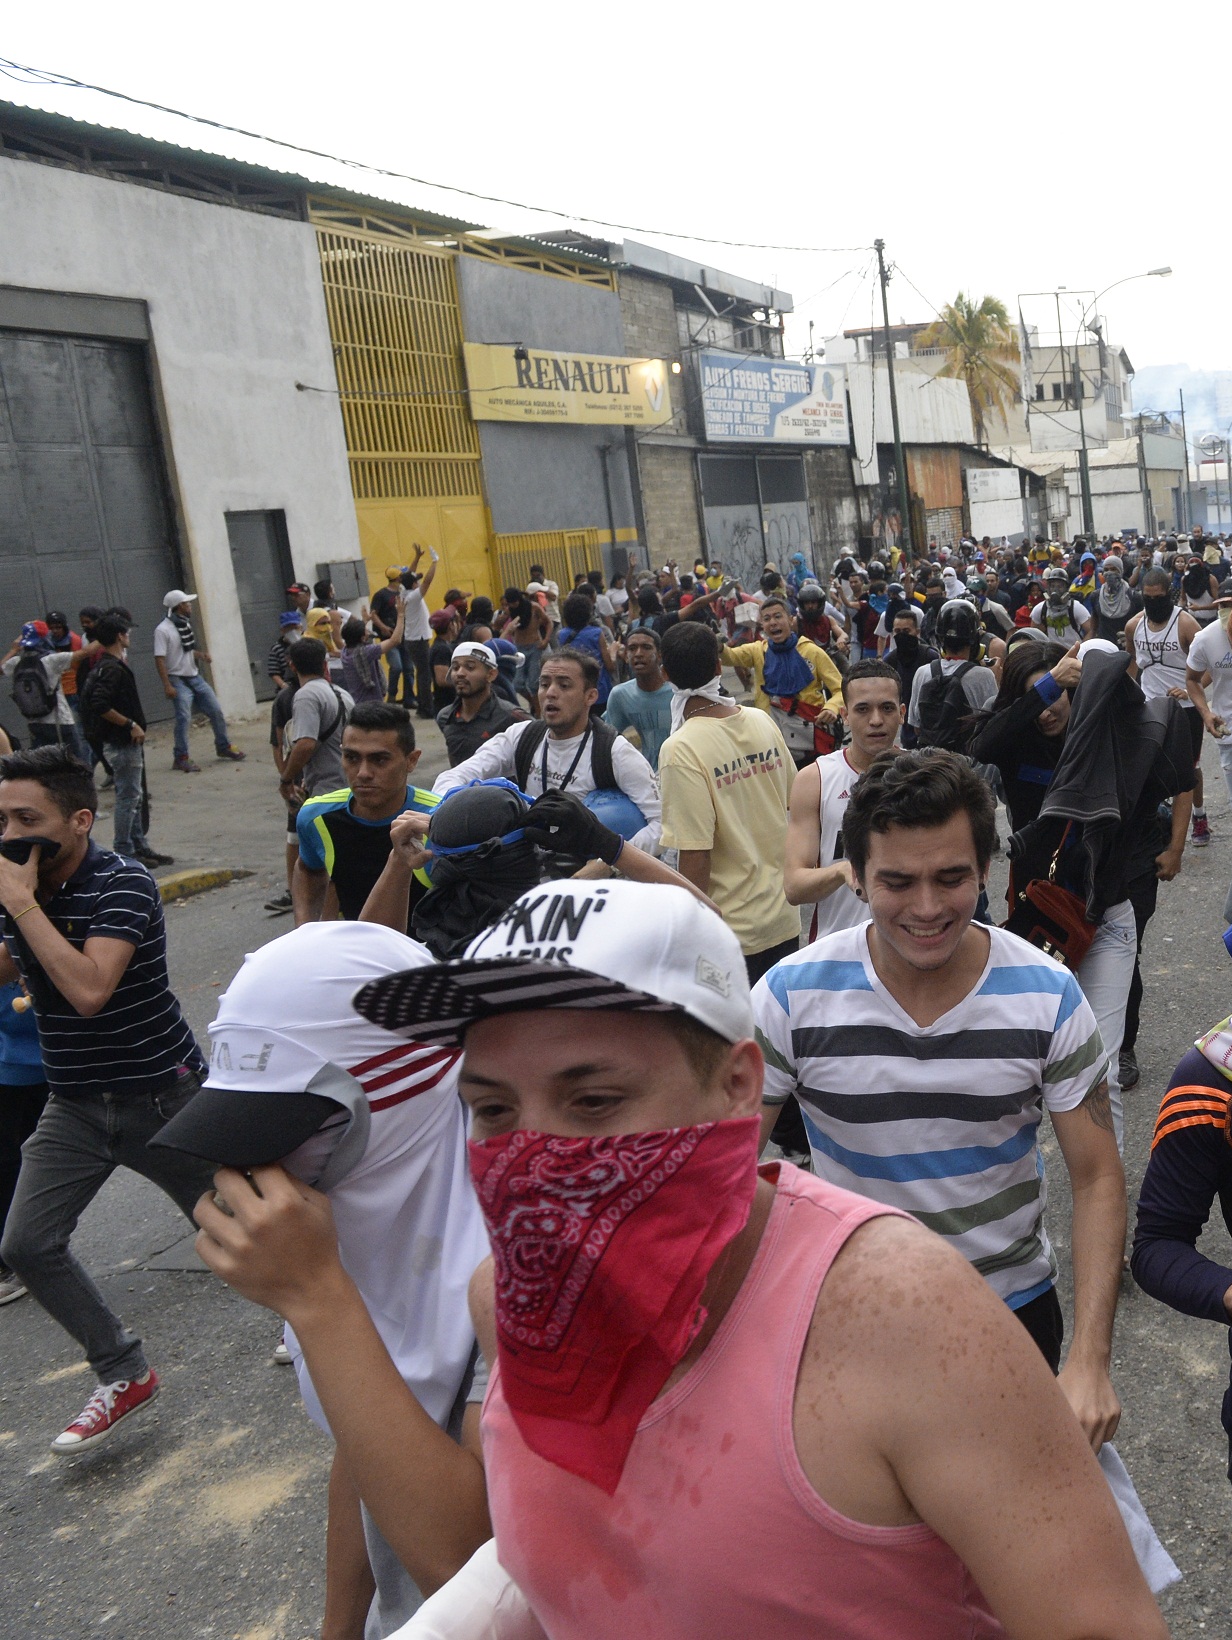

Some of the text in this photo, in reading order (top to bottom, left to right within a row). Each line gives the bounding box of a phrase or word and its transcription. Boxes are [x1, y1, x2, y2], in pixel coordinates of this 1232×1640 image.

[515, 356, 631, 395] RENAULT
[705, 366, 732, 388] AUTO
[733, 370, 770, 391] FRENOS
[713, 747, 783, 790] NAUTICA
